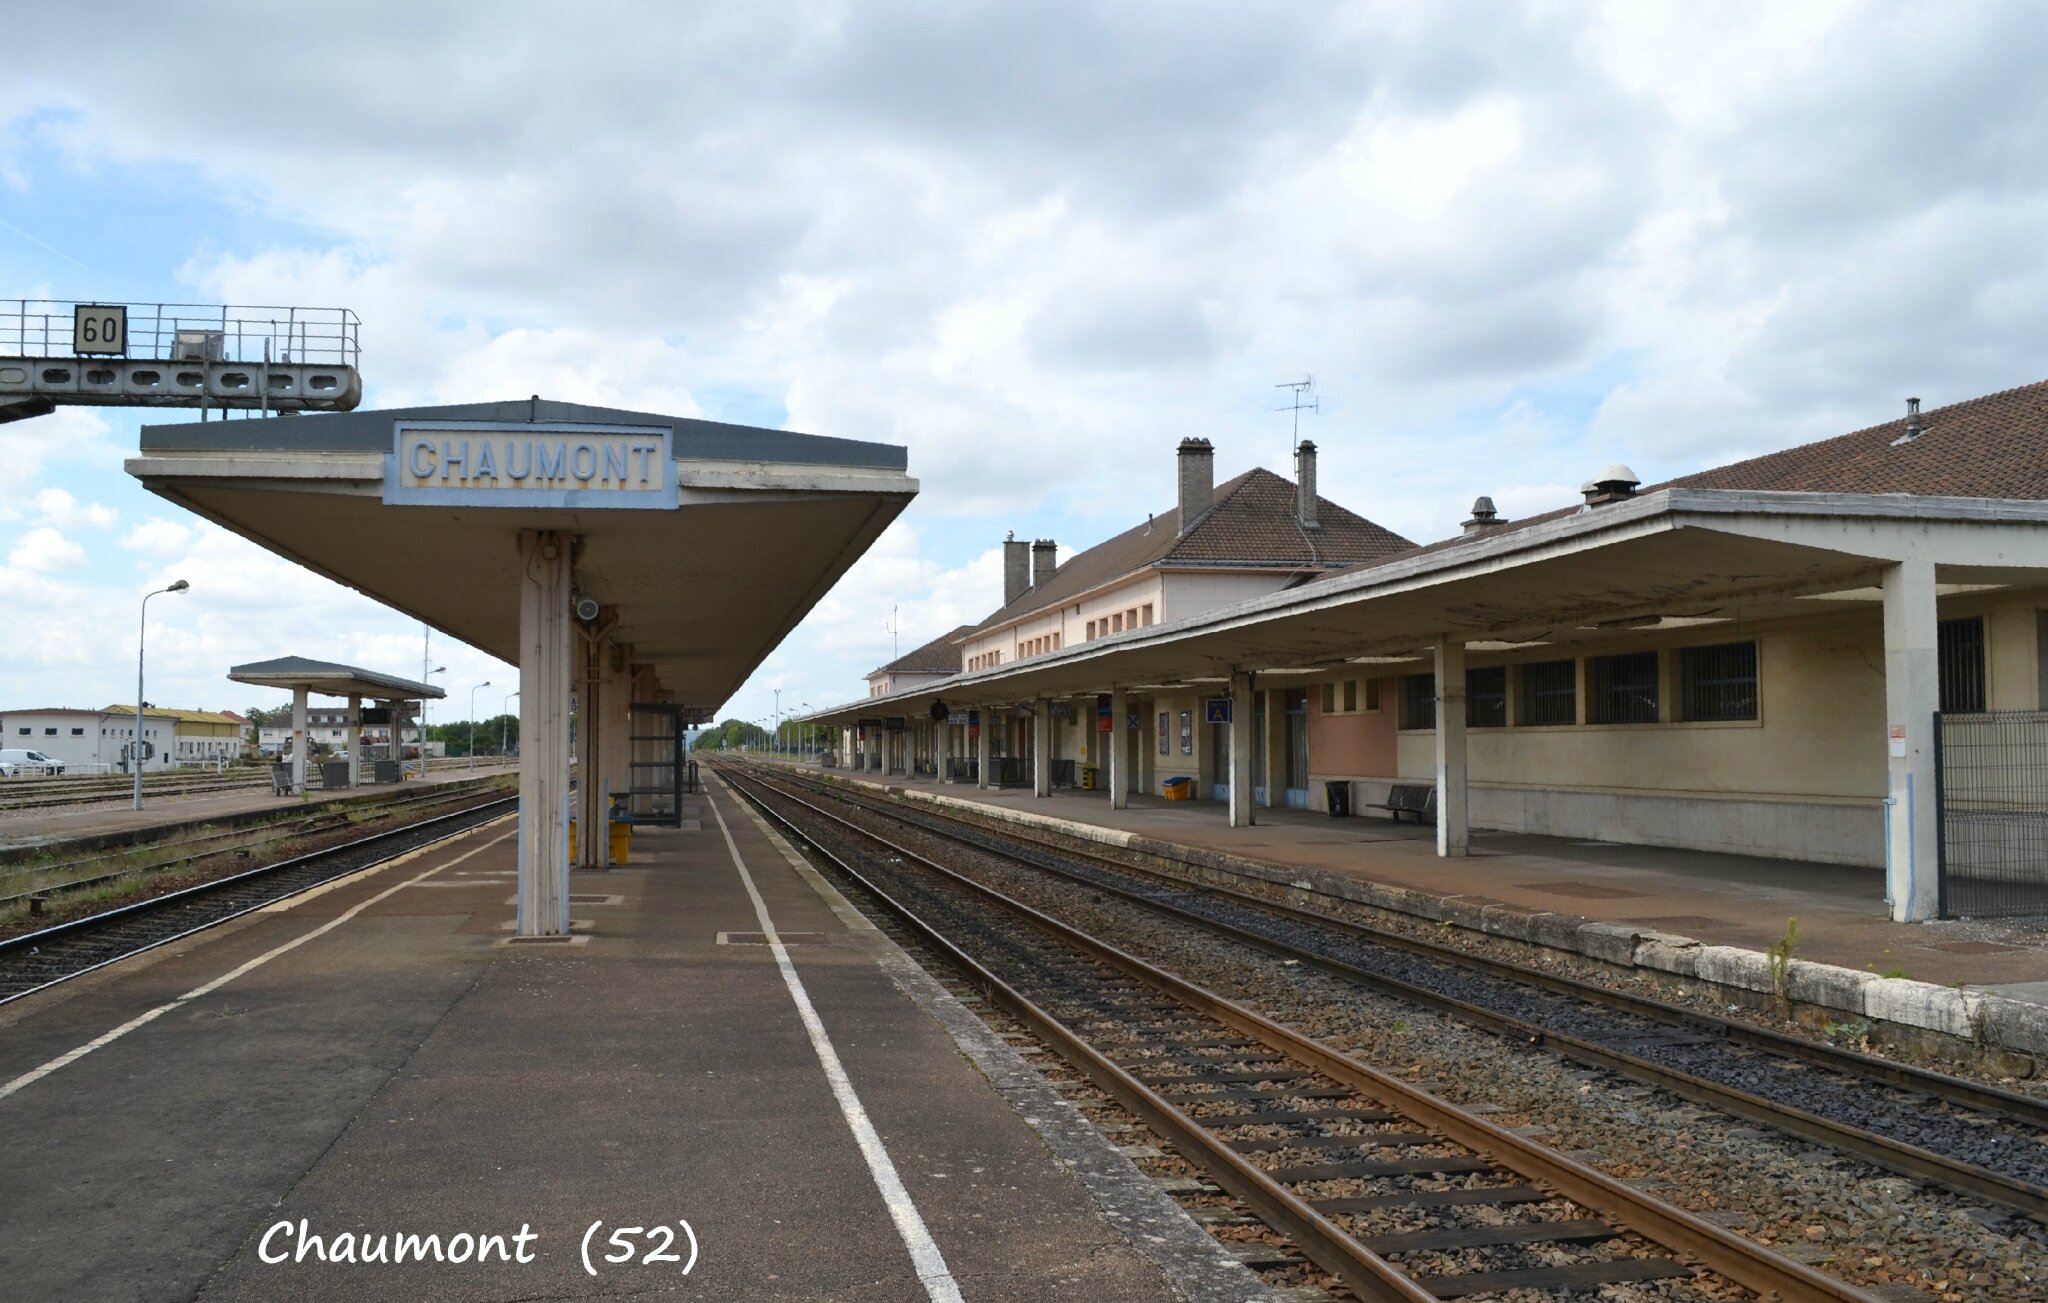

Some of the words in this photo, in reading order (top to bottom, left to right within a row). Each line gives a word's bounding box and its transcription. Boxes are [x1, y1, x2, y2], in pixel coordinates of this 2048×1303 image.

[83, 317, 117, 343] 60
[409, 438, 656, 483] CHAUMONT
[1212, 708, 1224, 721] A
